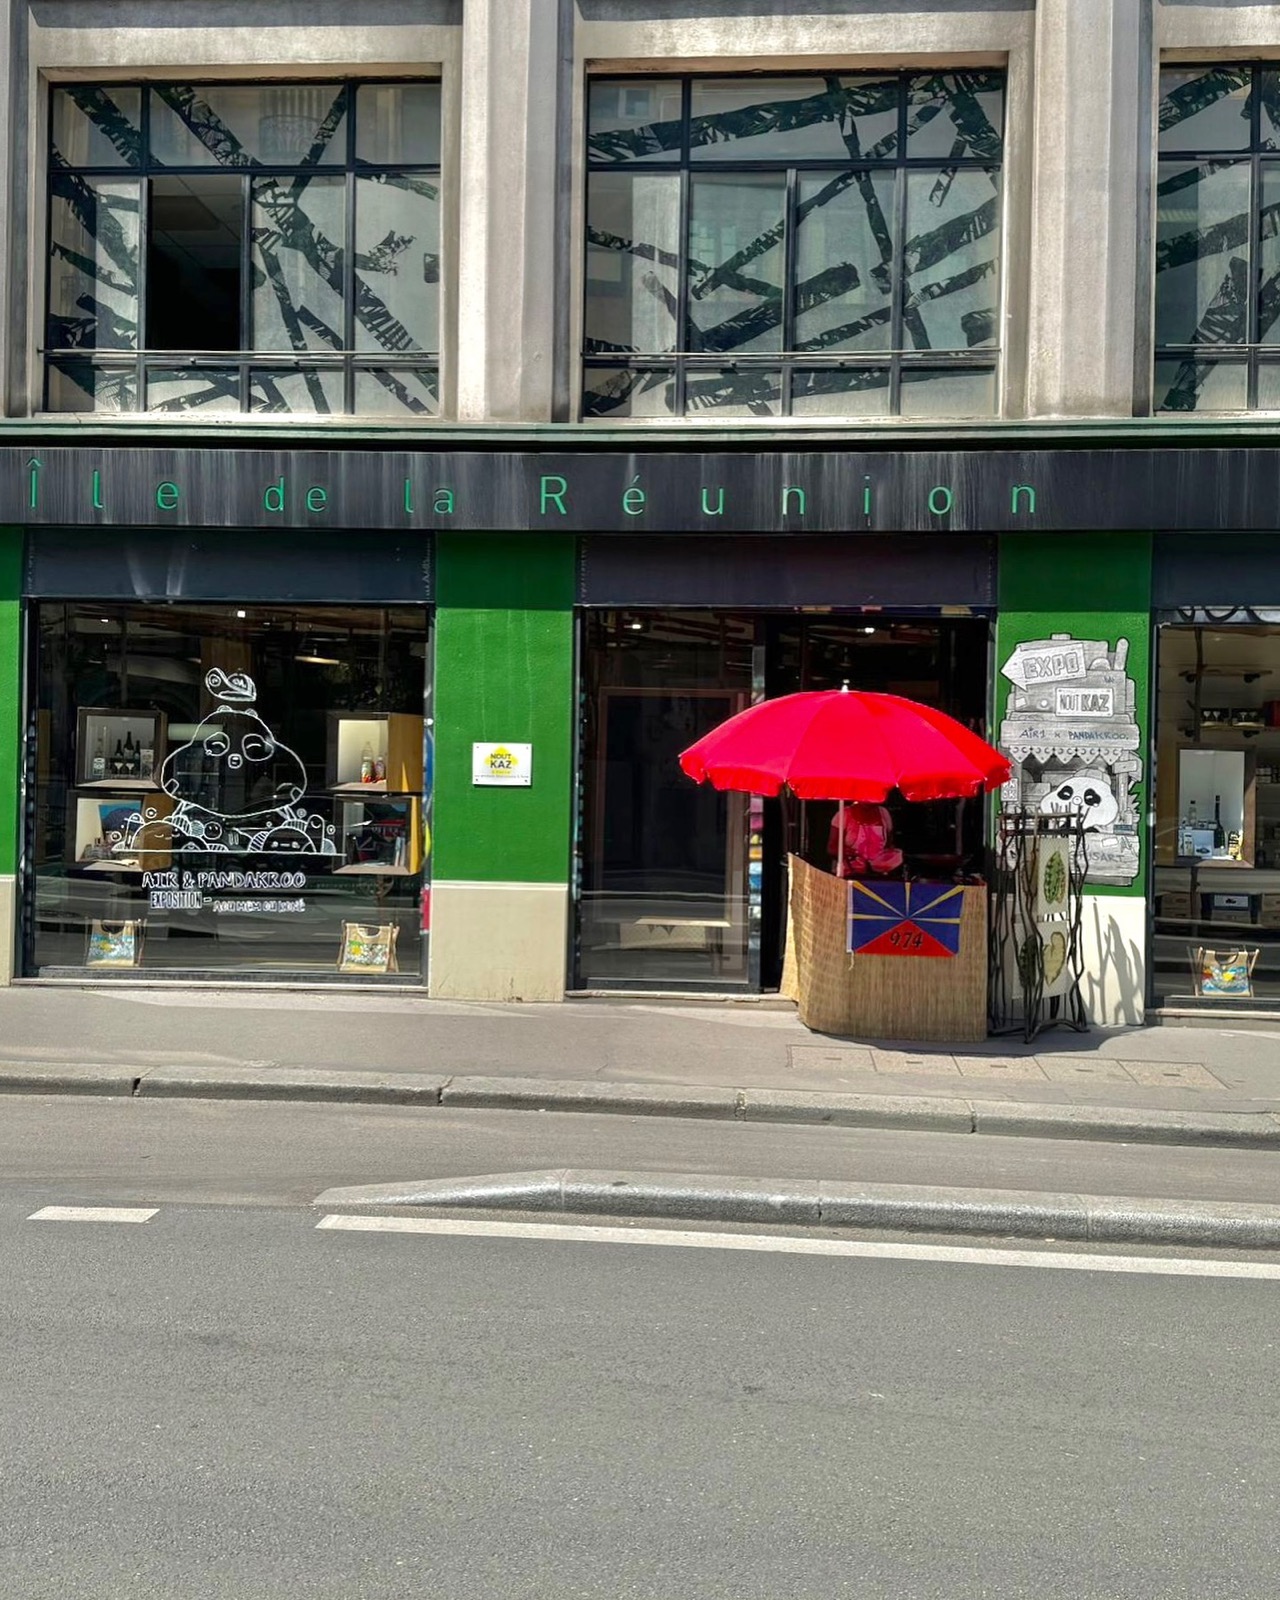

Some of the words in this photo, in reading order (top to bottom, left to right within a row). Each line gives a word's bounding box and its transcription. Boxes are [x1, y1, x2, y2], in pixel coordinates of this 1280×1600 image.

[26, 458, 180, 510] Île
[264, 476, 327, 513] de
[403, 479, 455, 515] la
[539, 474, 1036, 515] Réunion
[1022, 652, 1079, 679] EXPO
[1059, 693, 1080, 711] NOUT
[1081, 693, 1110, 712] KAZ
[490, 760, 512, 769] KAZ
[142, 871, 179, 888] AIR
[183, 871, 194, 888] &
[150, 891, 202, 909] EXPOSITION
[890, 932, 922, 949] 974
